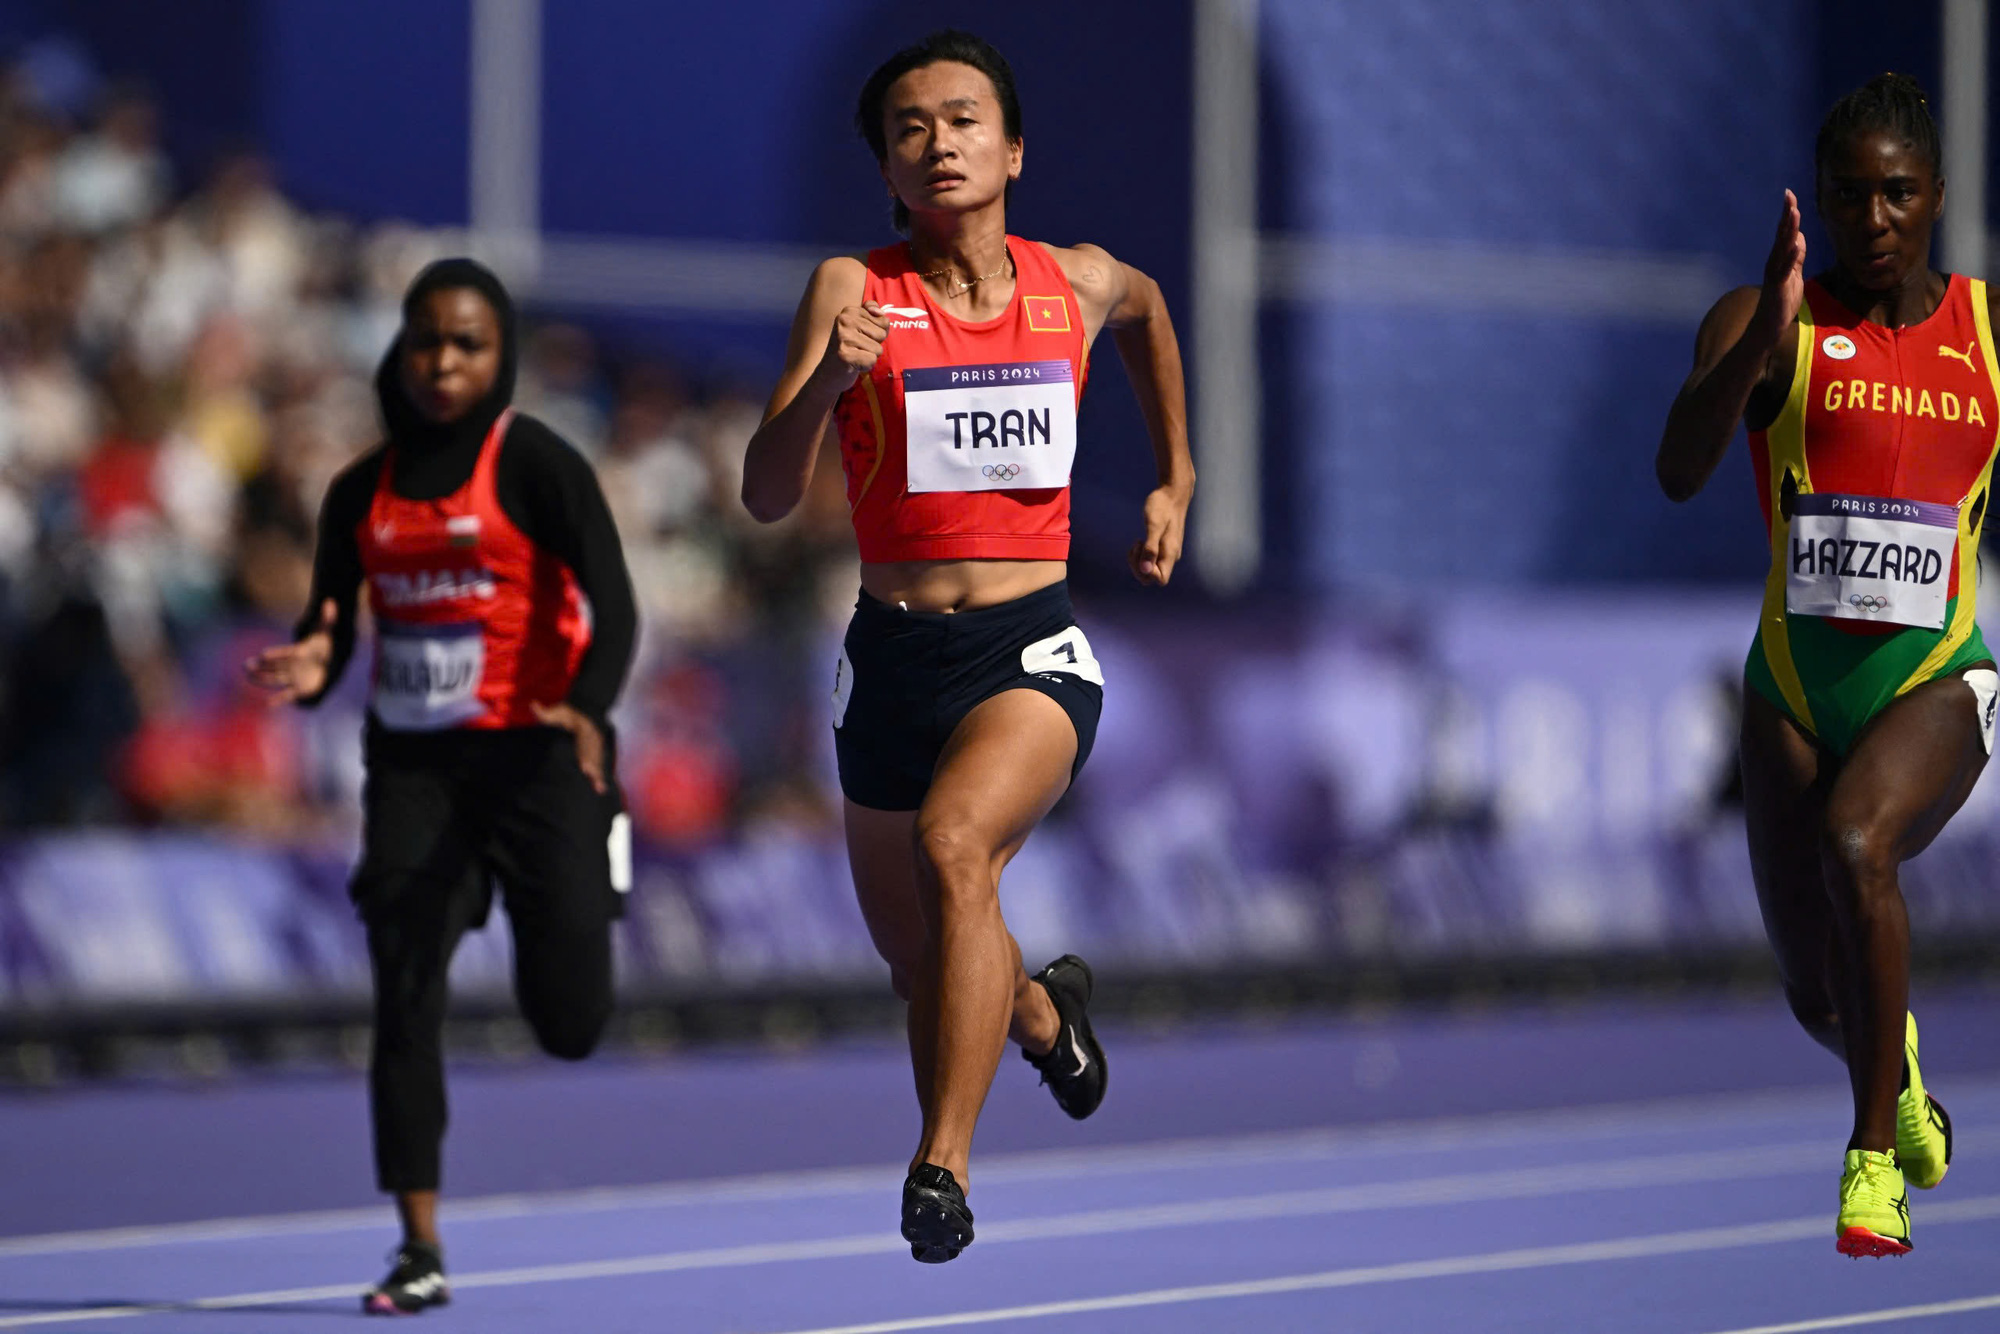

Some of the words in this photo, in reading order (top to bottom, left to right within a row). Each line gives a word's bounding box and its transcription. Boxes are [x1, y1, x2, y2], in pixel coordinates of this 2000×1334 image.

[1001, 367, 1040, 380] 2024
[1824, 379, 1986, 427] GRENADA
[945, 407, 1051, 450] TRAN
[1881, 502, 1920, 517] 2024
[1793, 537, 1943, 586] HAZZARD
